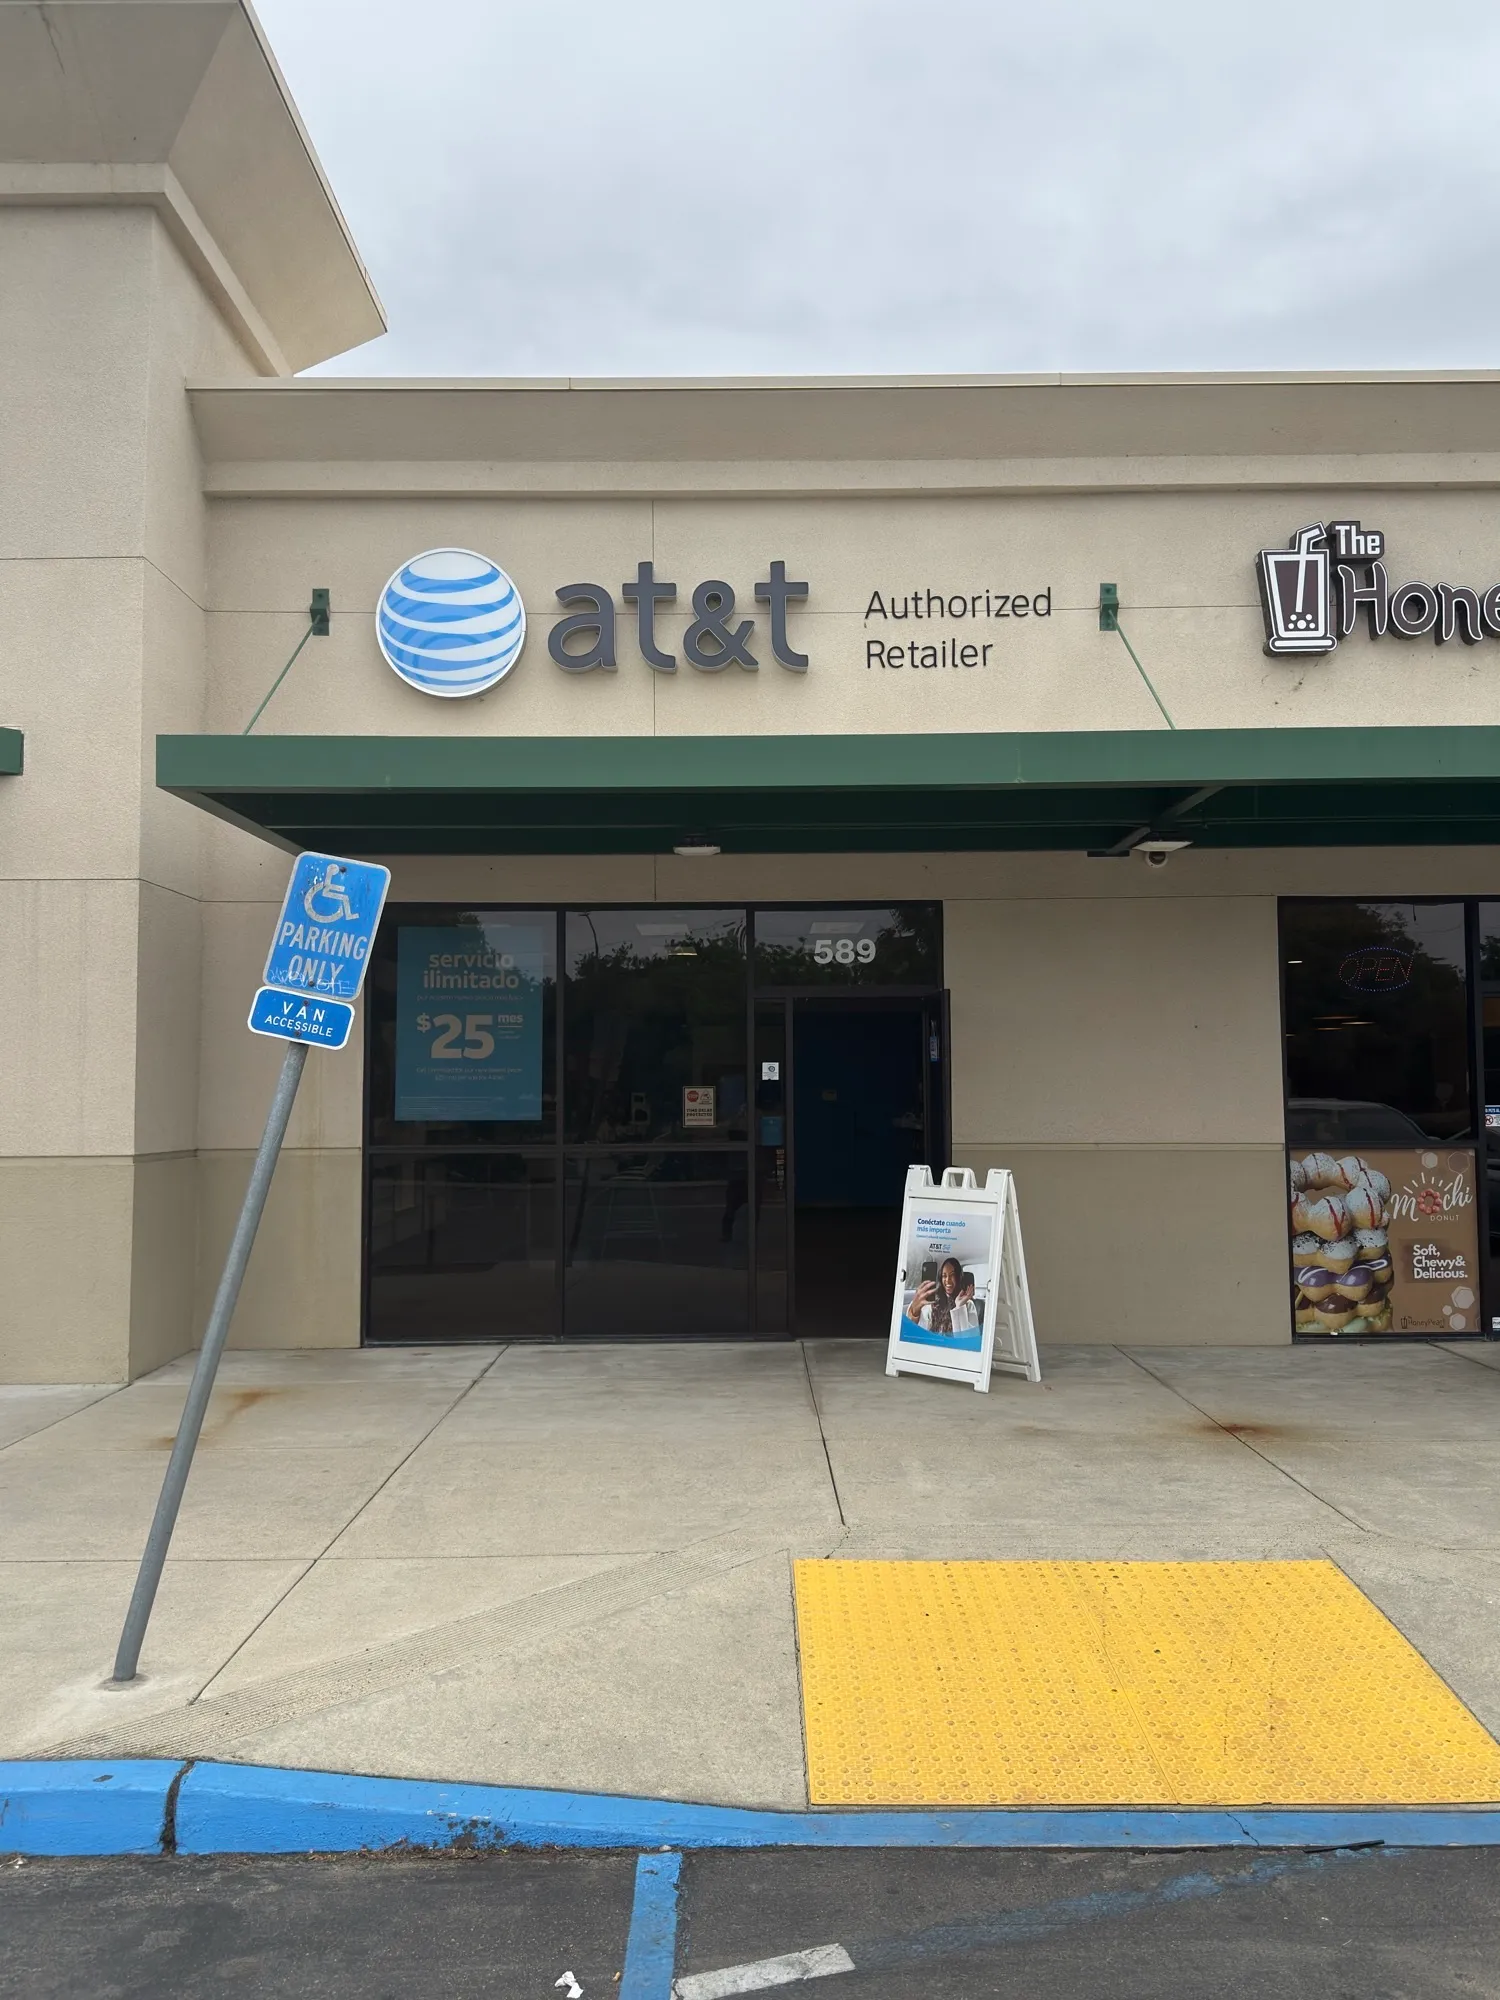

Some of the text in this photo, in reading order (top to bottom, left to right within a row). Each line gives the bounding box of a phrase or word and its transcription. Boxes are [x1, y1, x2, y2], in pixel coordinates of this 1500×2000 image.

[1335, 525, 1381, 555] The
[864, 587, 1053, 620] Authorized
[547, 560, 809, 673] at&t
[864, 637, 994, 669] Retailer
[279, 921, 368, 960] PARKING
[813, 939, 877, 964] 589
[288, 955, 344, 985] ONLY
[429, 951, 515, 968] servicio
[1338, 957, 1414, 982] OPEN
[423, 970, 519, 989] ilimitado
[282, 1001, 326, 1023] VAN
[264, 1016, 333, 1038] ACCESSIBLE
[416, 1013, 524, 1060] $25 mes
[917, 1218, 945, 1226] Conéctate
[929, 1226, 951, 1234] importa
[1413, 1244, 1440, 1257] Soft,
[1413, 1256, 1466, 1269] Chewy&
[1413, 1268, 1468, 1279] Delicious.
